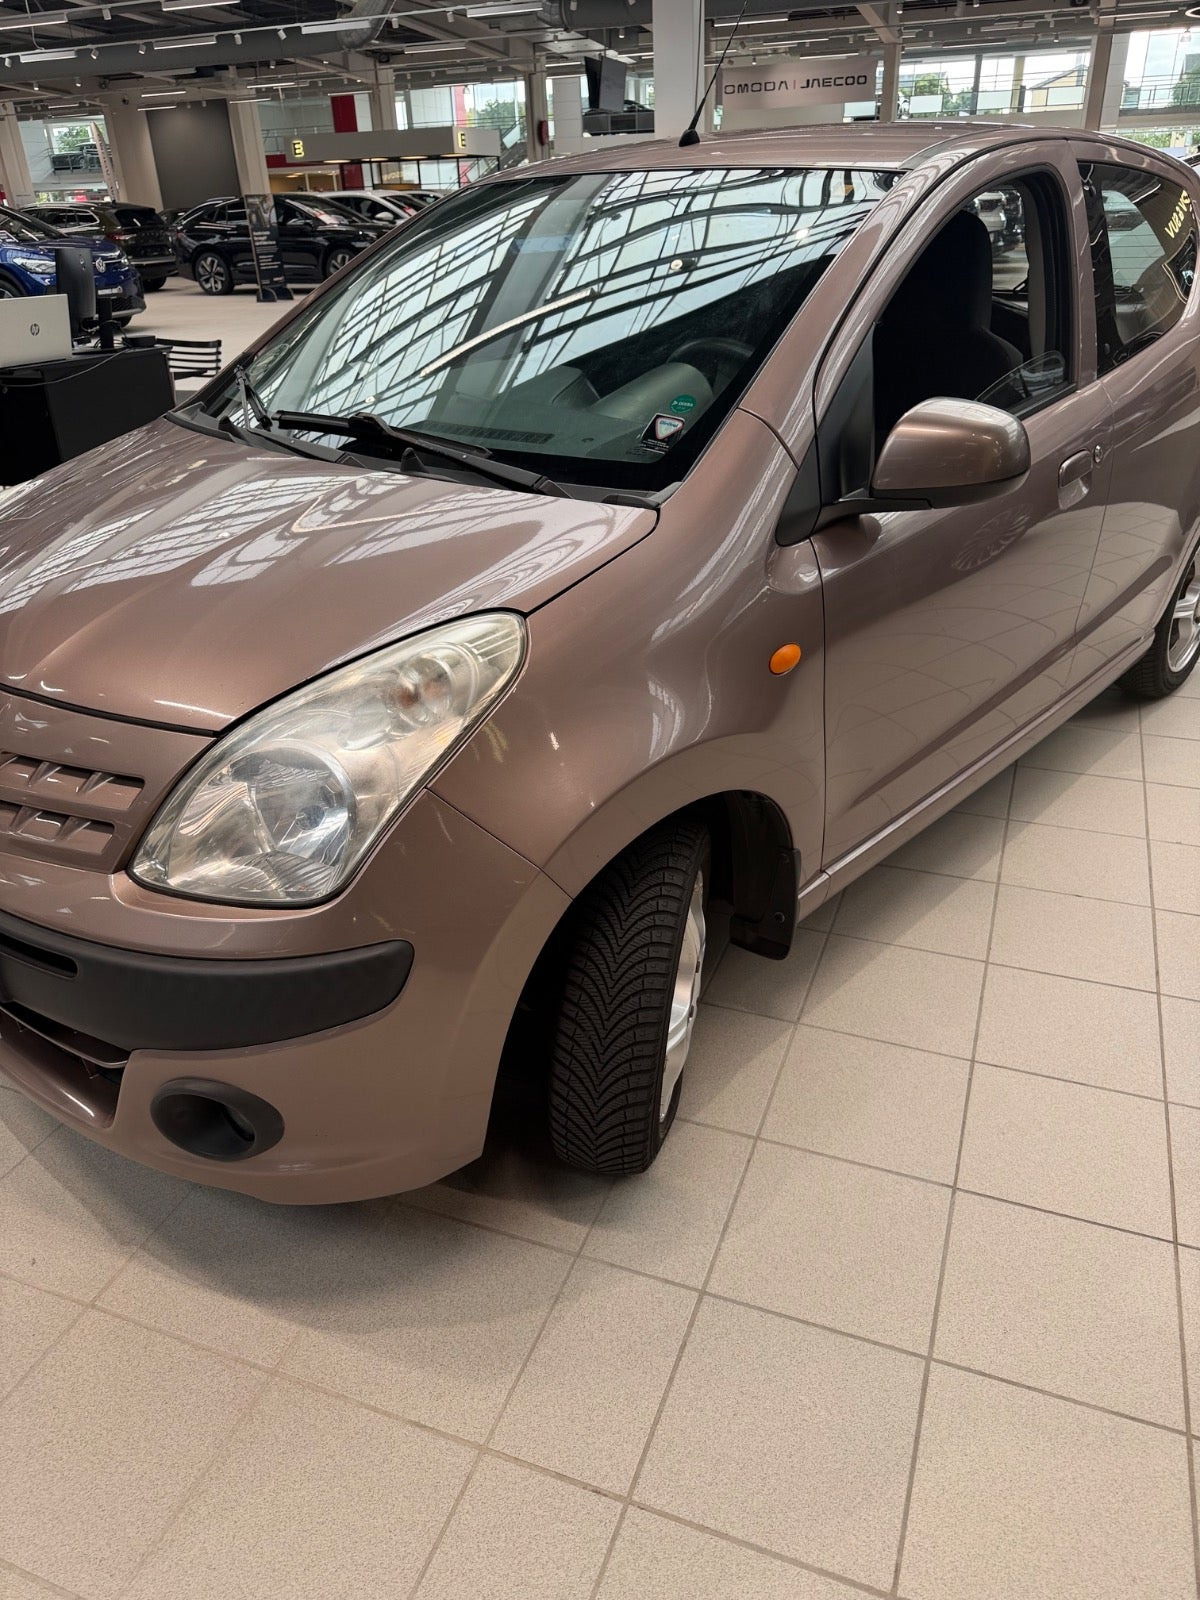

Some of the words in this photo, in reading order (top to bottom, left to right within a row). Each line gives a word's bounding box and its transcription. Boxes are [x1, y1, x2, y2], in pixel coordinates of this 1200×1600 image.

[724, 80, 788, 95] OMODA
[800, 75, 867, 89] JAECOO
[458, 131, 466, 148] E
